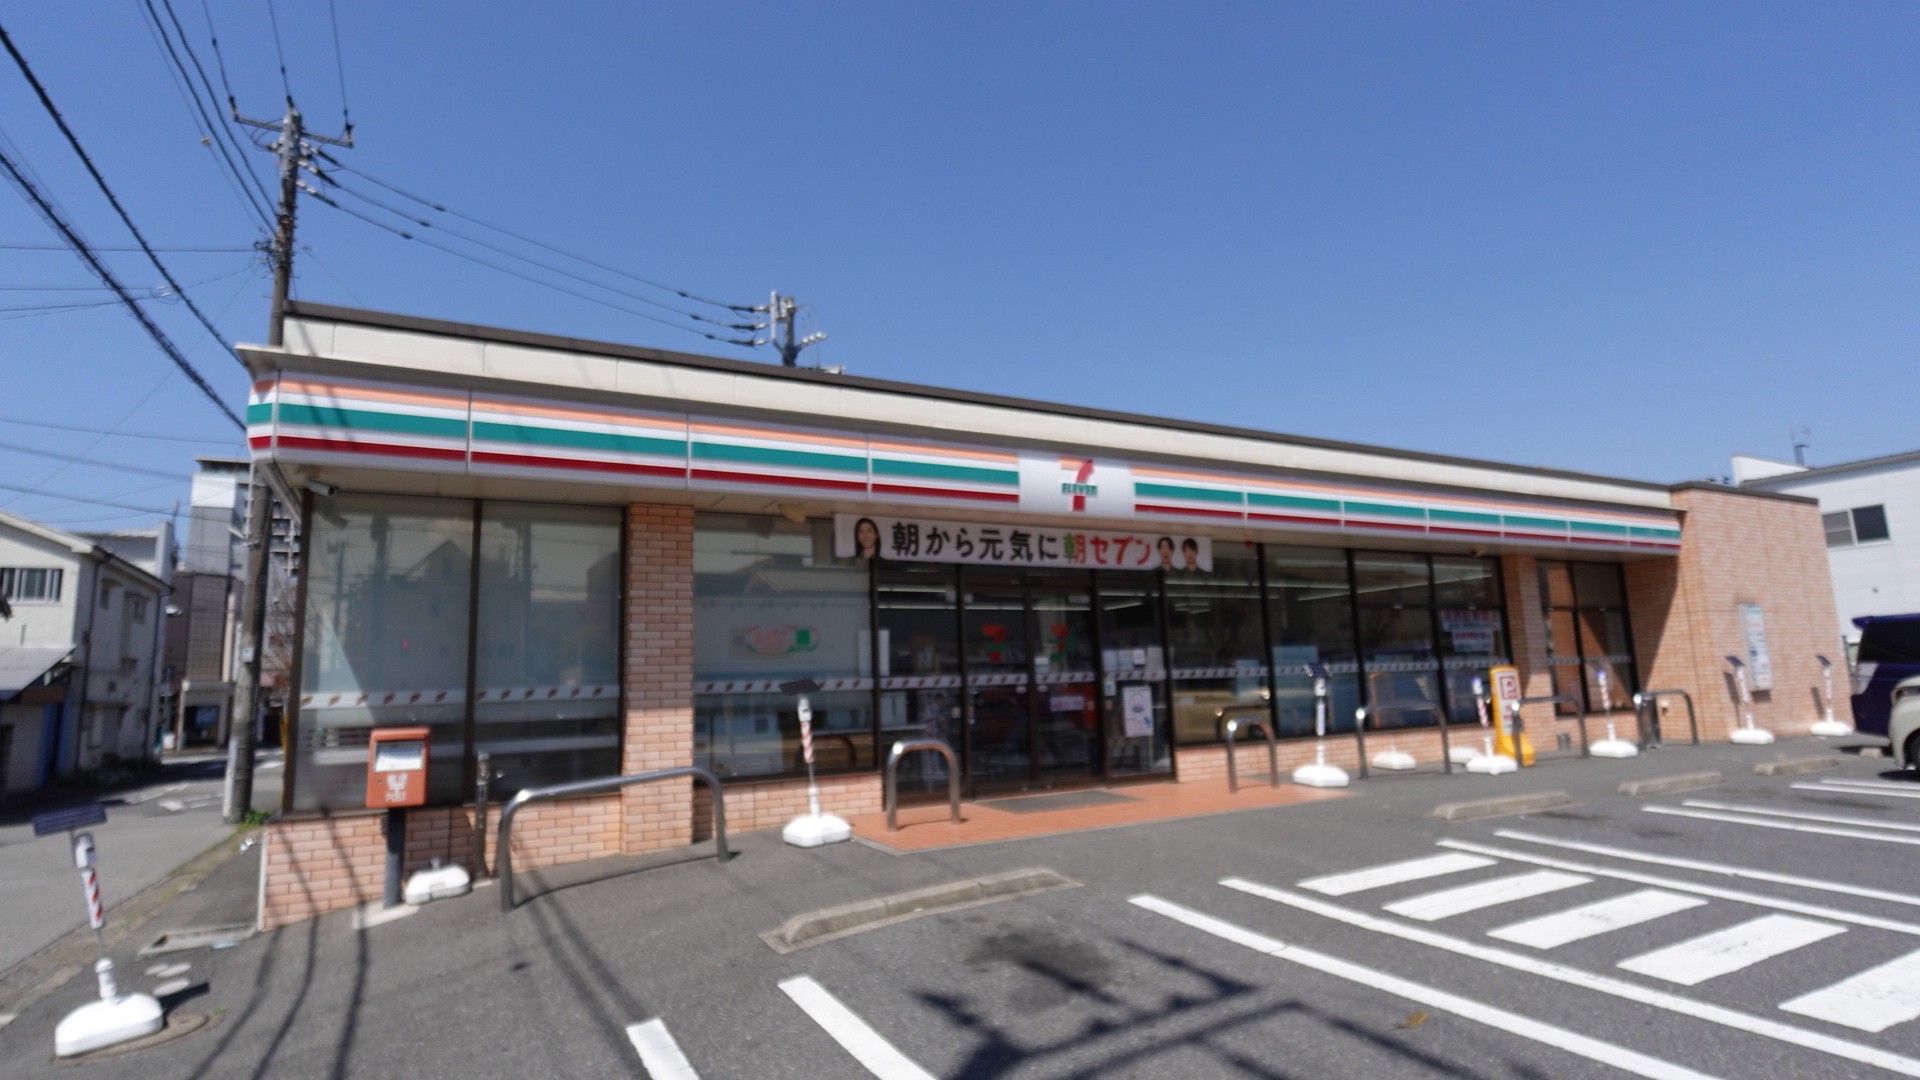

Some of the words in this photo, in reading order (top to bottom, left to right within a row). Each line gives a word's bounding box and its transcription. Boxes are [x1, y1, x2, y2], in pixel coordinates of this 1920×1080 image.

[1059, 456, 1095, 511] 7
[891, 521, 1151, 567] 朝から元気に朝セブン
[386, 792, 406, 802] POST
